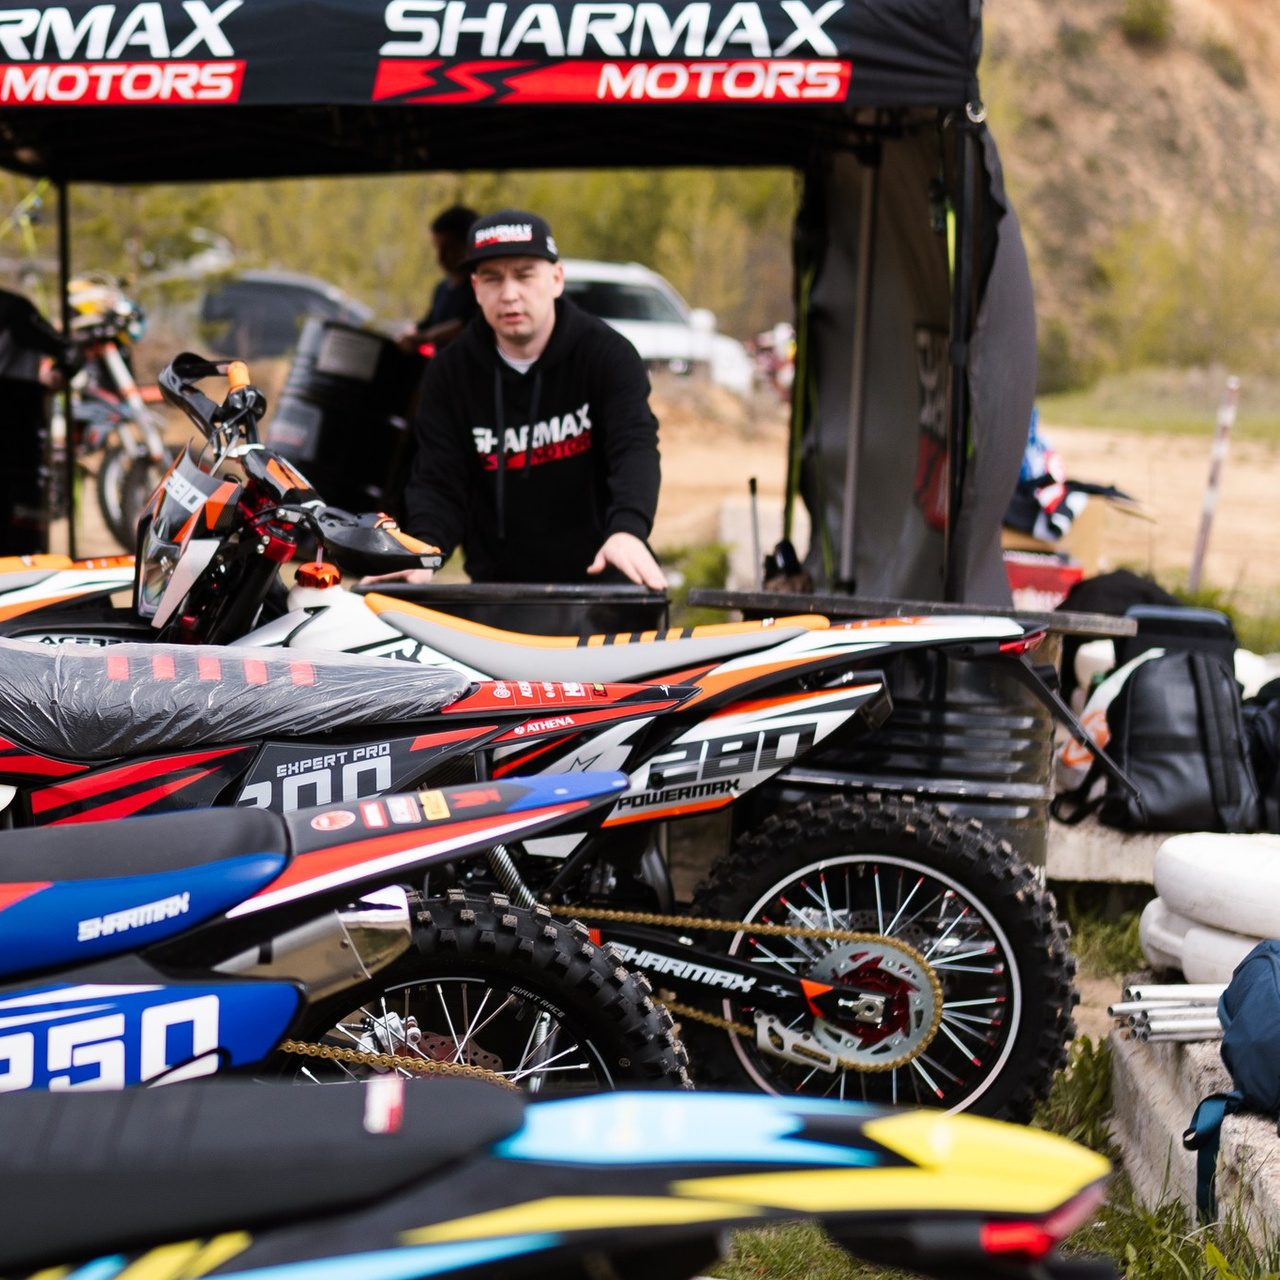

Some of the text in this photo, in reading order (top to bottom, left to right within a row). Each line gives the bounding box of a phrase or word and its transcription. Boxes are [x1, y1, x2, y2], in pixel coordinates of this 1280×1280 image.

[0, 60, 236, 102] MOTORS
[597, 60, 842, 102] MOTORS
[526, 716, 575, 732] ATHENA
[276, 743, 391, 778] EXPERT PRO
[644, 722, 819, 790] 280
[616, 778, 741, 811] POWERMAX
[77, 891, 191, 942] SHARMAX
[510, 985, 567, 1019] GIANT RACE
